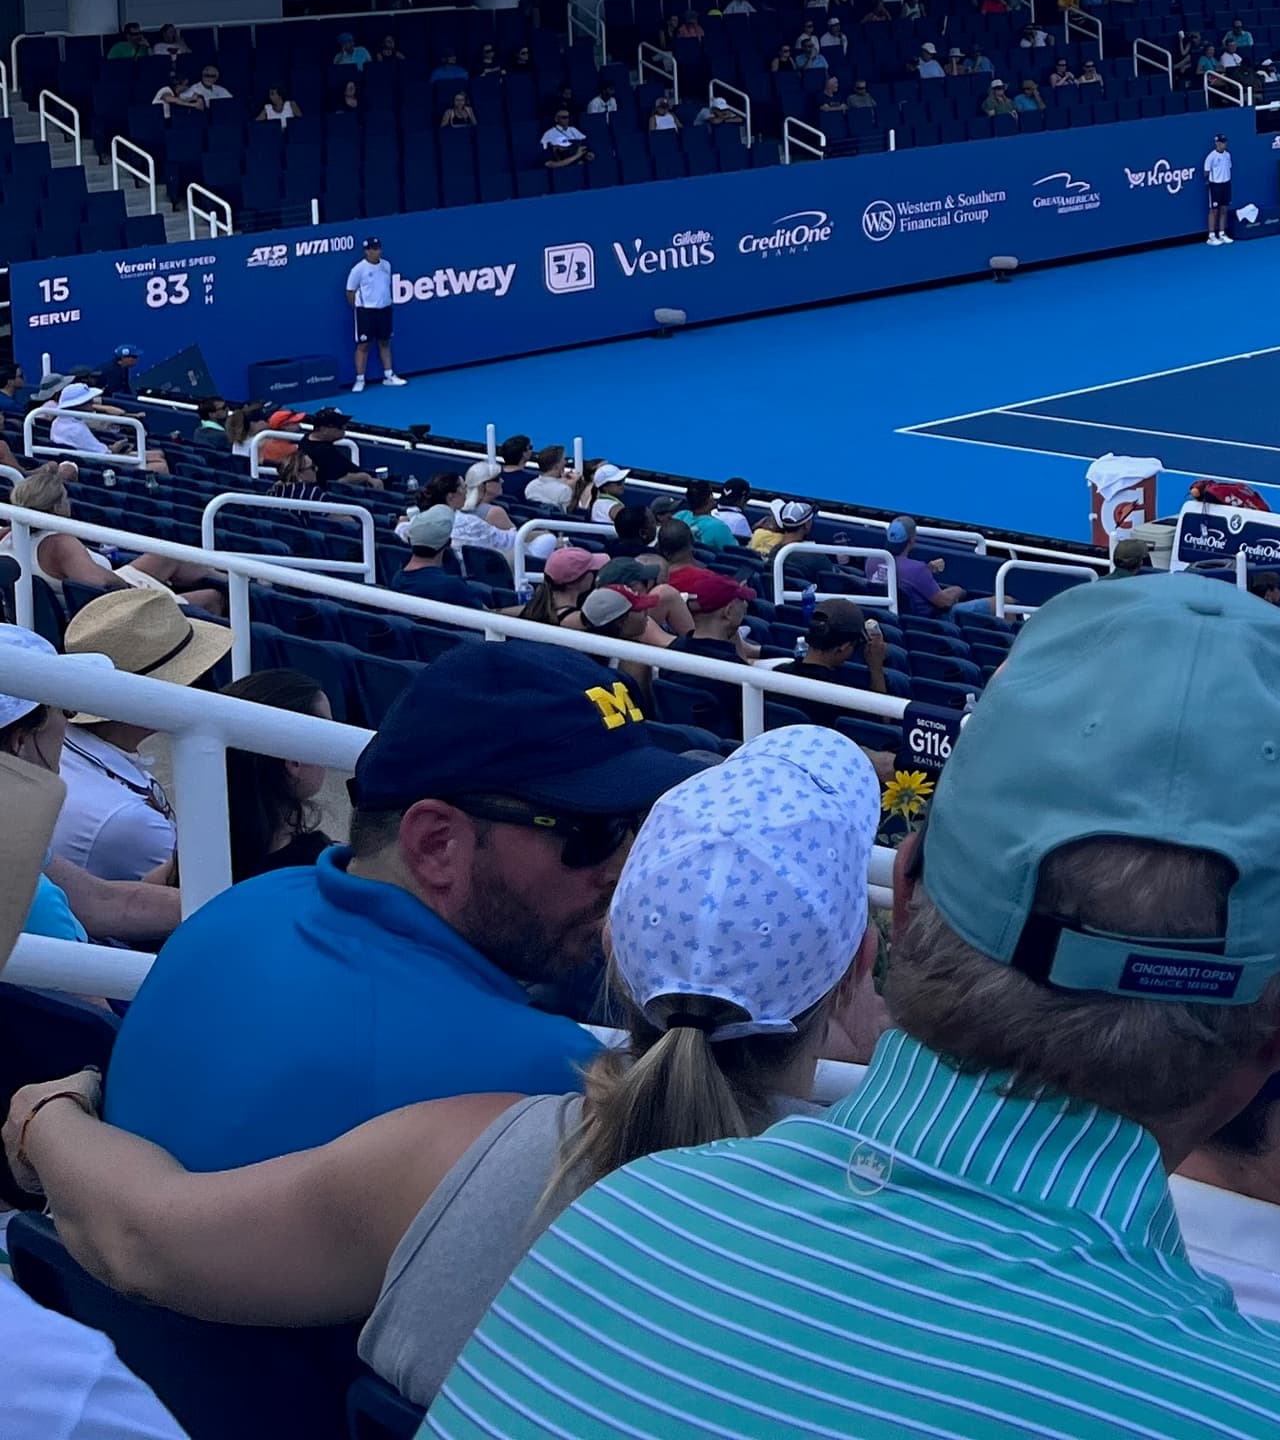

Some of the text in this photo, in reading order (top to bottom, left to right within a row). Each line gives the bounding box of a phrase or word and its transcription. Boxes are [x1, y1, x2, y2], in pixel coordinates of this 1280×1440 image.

[1148, 159, 1196, 194] Kroger
[897, 189, 1006, 216] Western & Southern
[900, 208, 989, 233] Financial Group
[296, 235, 354, 256] WTA 1000
[672, 230, 710, 248] Gillette
[159, 259, 187, 271] SERVE
[189, 256, 216, 267] SPEED
[613, 237, 715, 277] Venus
[39, 277, 70, 303] 15
[146, 273, 190, 308] 83
[392, 263, 517, 305] betway
[29, 309, 81, 328] SERVE
[585, 681, 644, 730] M
[917, 718, 946, 731] SECTION
[909, 728, 952, 758] G116
[1131, 962, 1236, 981] CINCINNATI OPEN
[1140, 977, 1182, 988] SINCE
